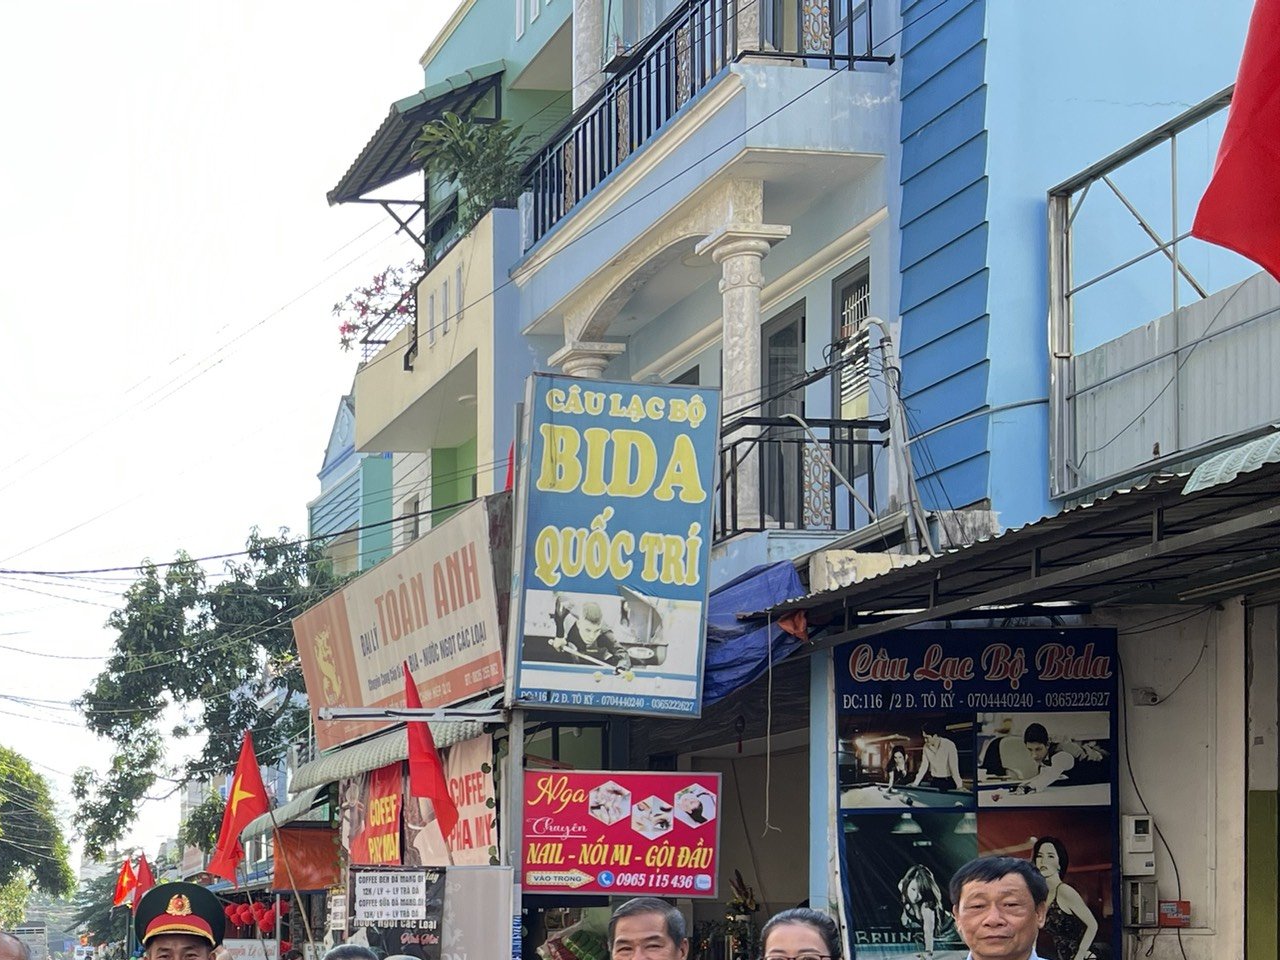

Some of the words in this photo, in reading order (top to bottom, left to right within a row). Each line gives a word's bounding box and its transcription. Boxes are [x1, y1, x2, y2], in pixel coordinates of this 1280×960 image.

[546, 384, 606, 416] CÂU
[608, 392, 665, 423] LẠC
[668, 394, 707, 429] BỘ
[536, 423, 707, 504] BIDA
[535, 506, 634, 587] QUỐC
[639, 522, 703, 586] TRÍ
[374, 572, 429, 647] TOÀN
[432, 541, 482, 620] ANH
[1035, 643, 1113, 681] Bida
[921, 691, 936, 708] TÔ
[940, 690, 956, 708] KÝ
[967, 692, 1034, 708] 0704440240
[1045, 692, 1111, 707] 0365222627
[527, 774, 589, 814] Nga
[526, 816, 587, 841] Chuyên
[526, 842, 565, 865] NAIL
[578, 835, 607, 866] NỐI
[610, 844, 631, 866] MI
[645, 839, 673, 873] GỘI
[677, 838, 713, 869] ĐẦU
[358, 876, 377, 884] COFFEE
[616, 872, 647, 887] 0965
[648, 873, 669, 887] 115
[671, 874, 693, 889] 436
